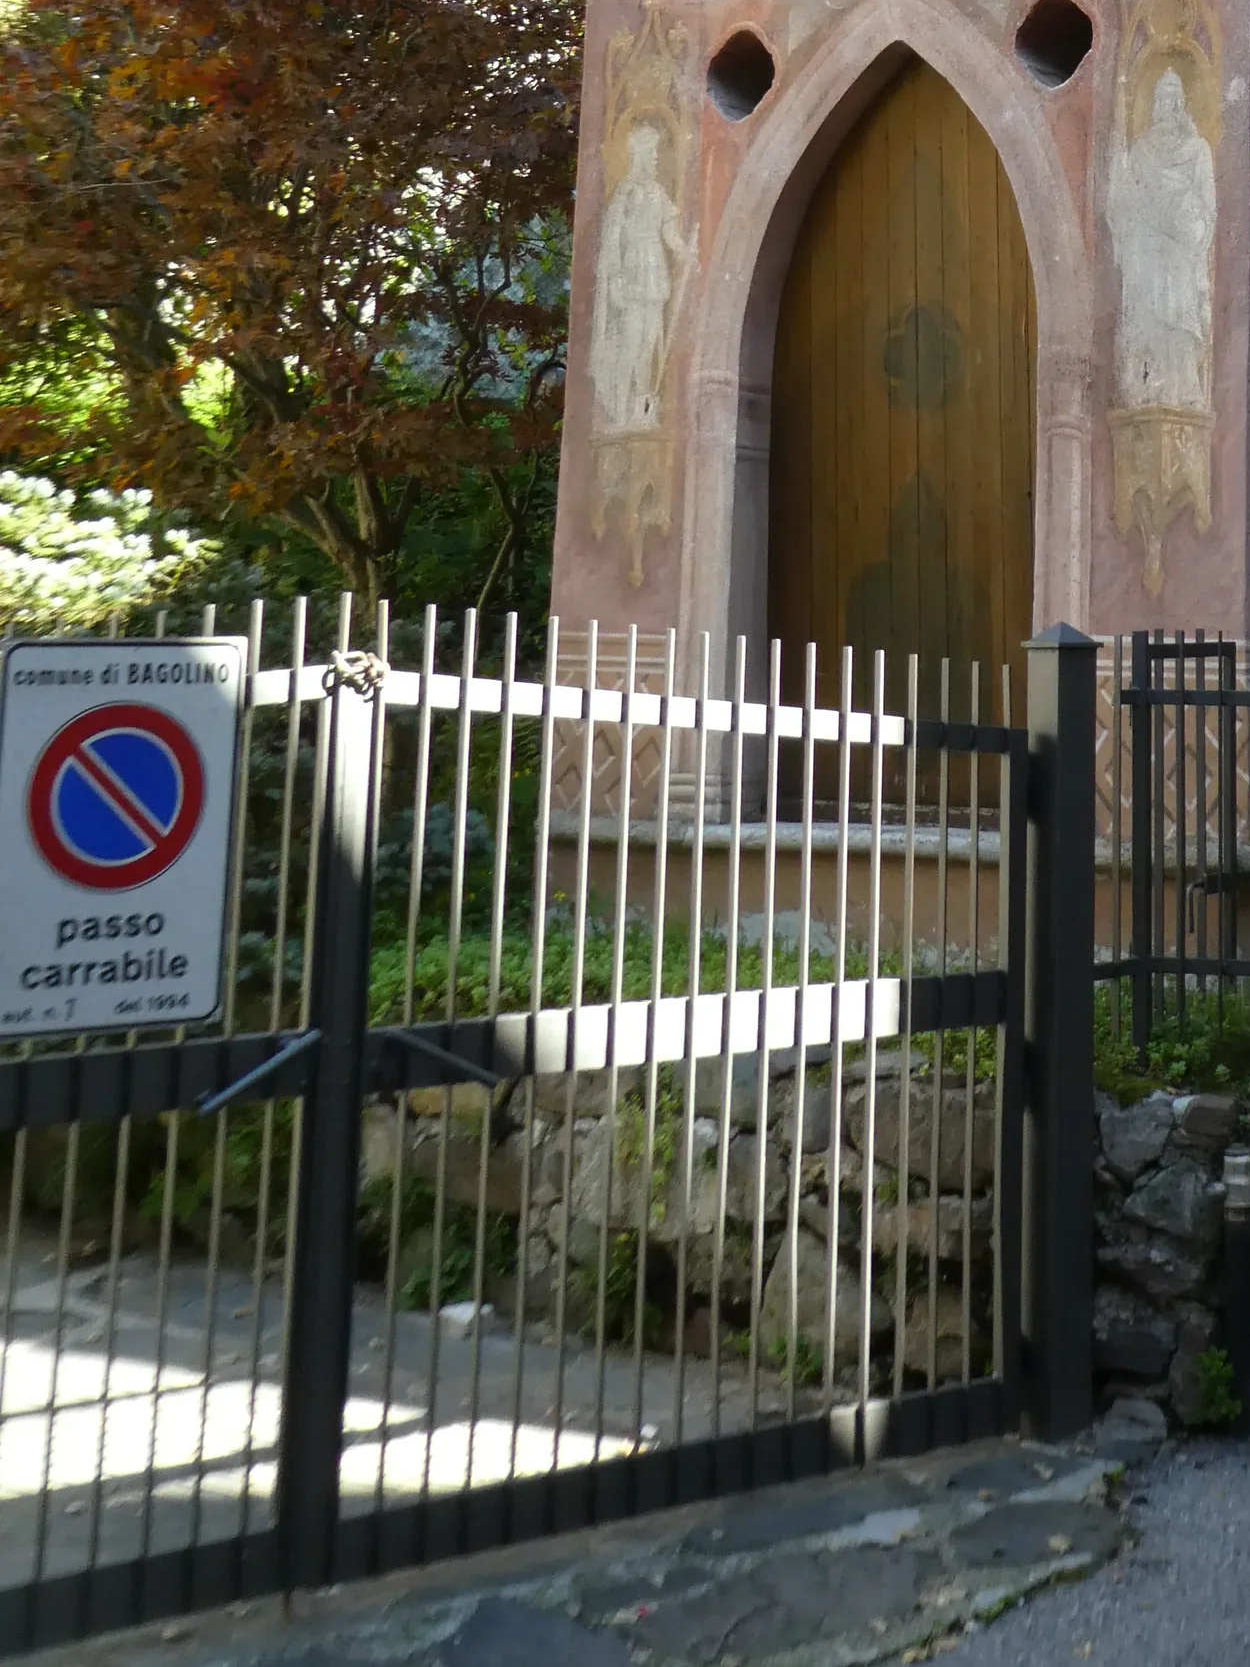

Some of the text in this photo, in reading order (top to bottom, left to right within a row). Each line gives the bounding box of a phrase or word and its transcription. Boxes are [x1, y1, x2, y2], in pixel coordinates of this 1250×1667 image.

[14, 662, 229, 685] comune di BAGOLINO
[56, 912, 165, 950] passo
[20, 948, 189, 990] carrabile
